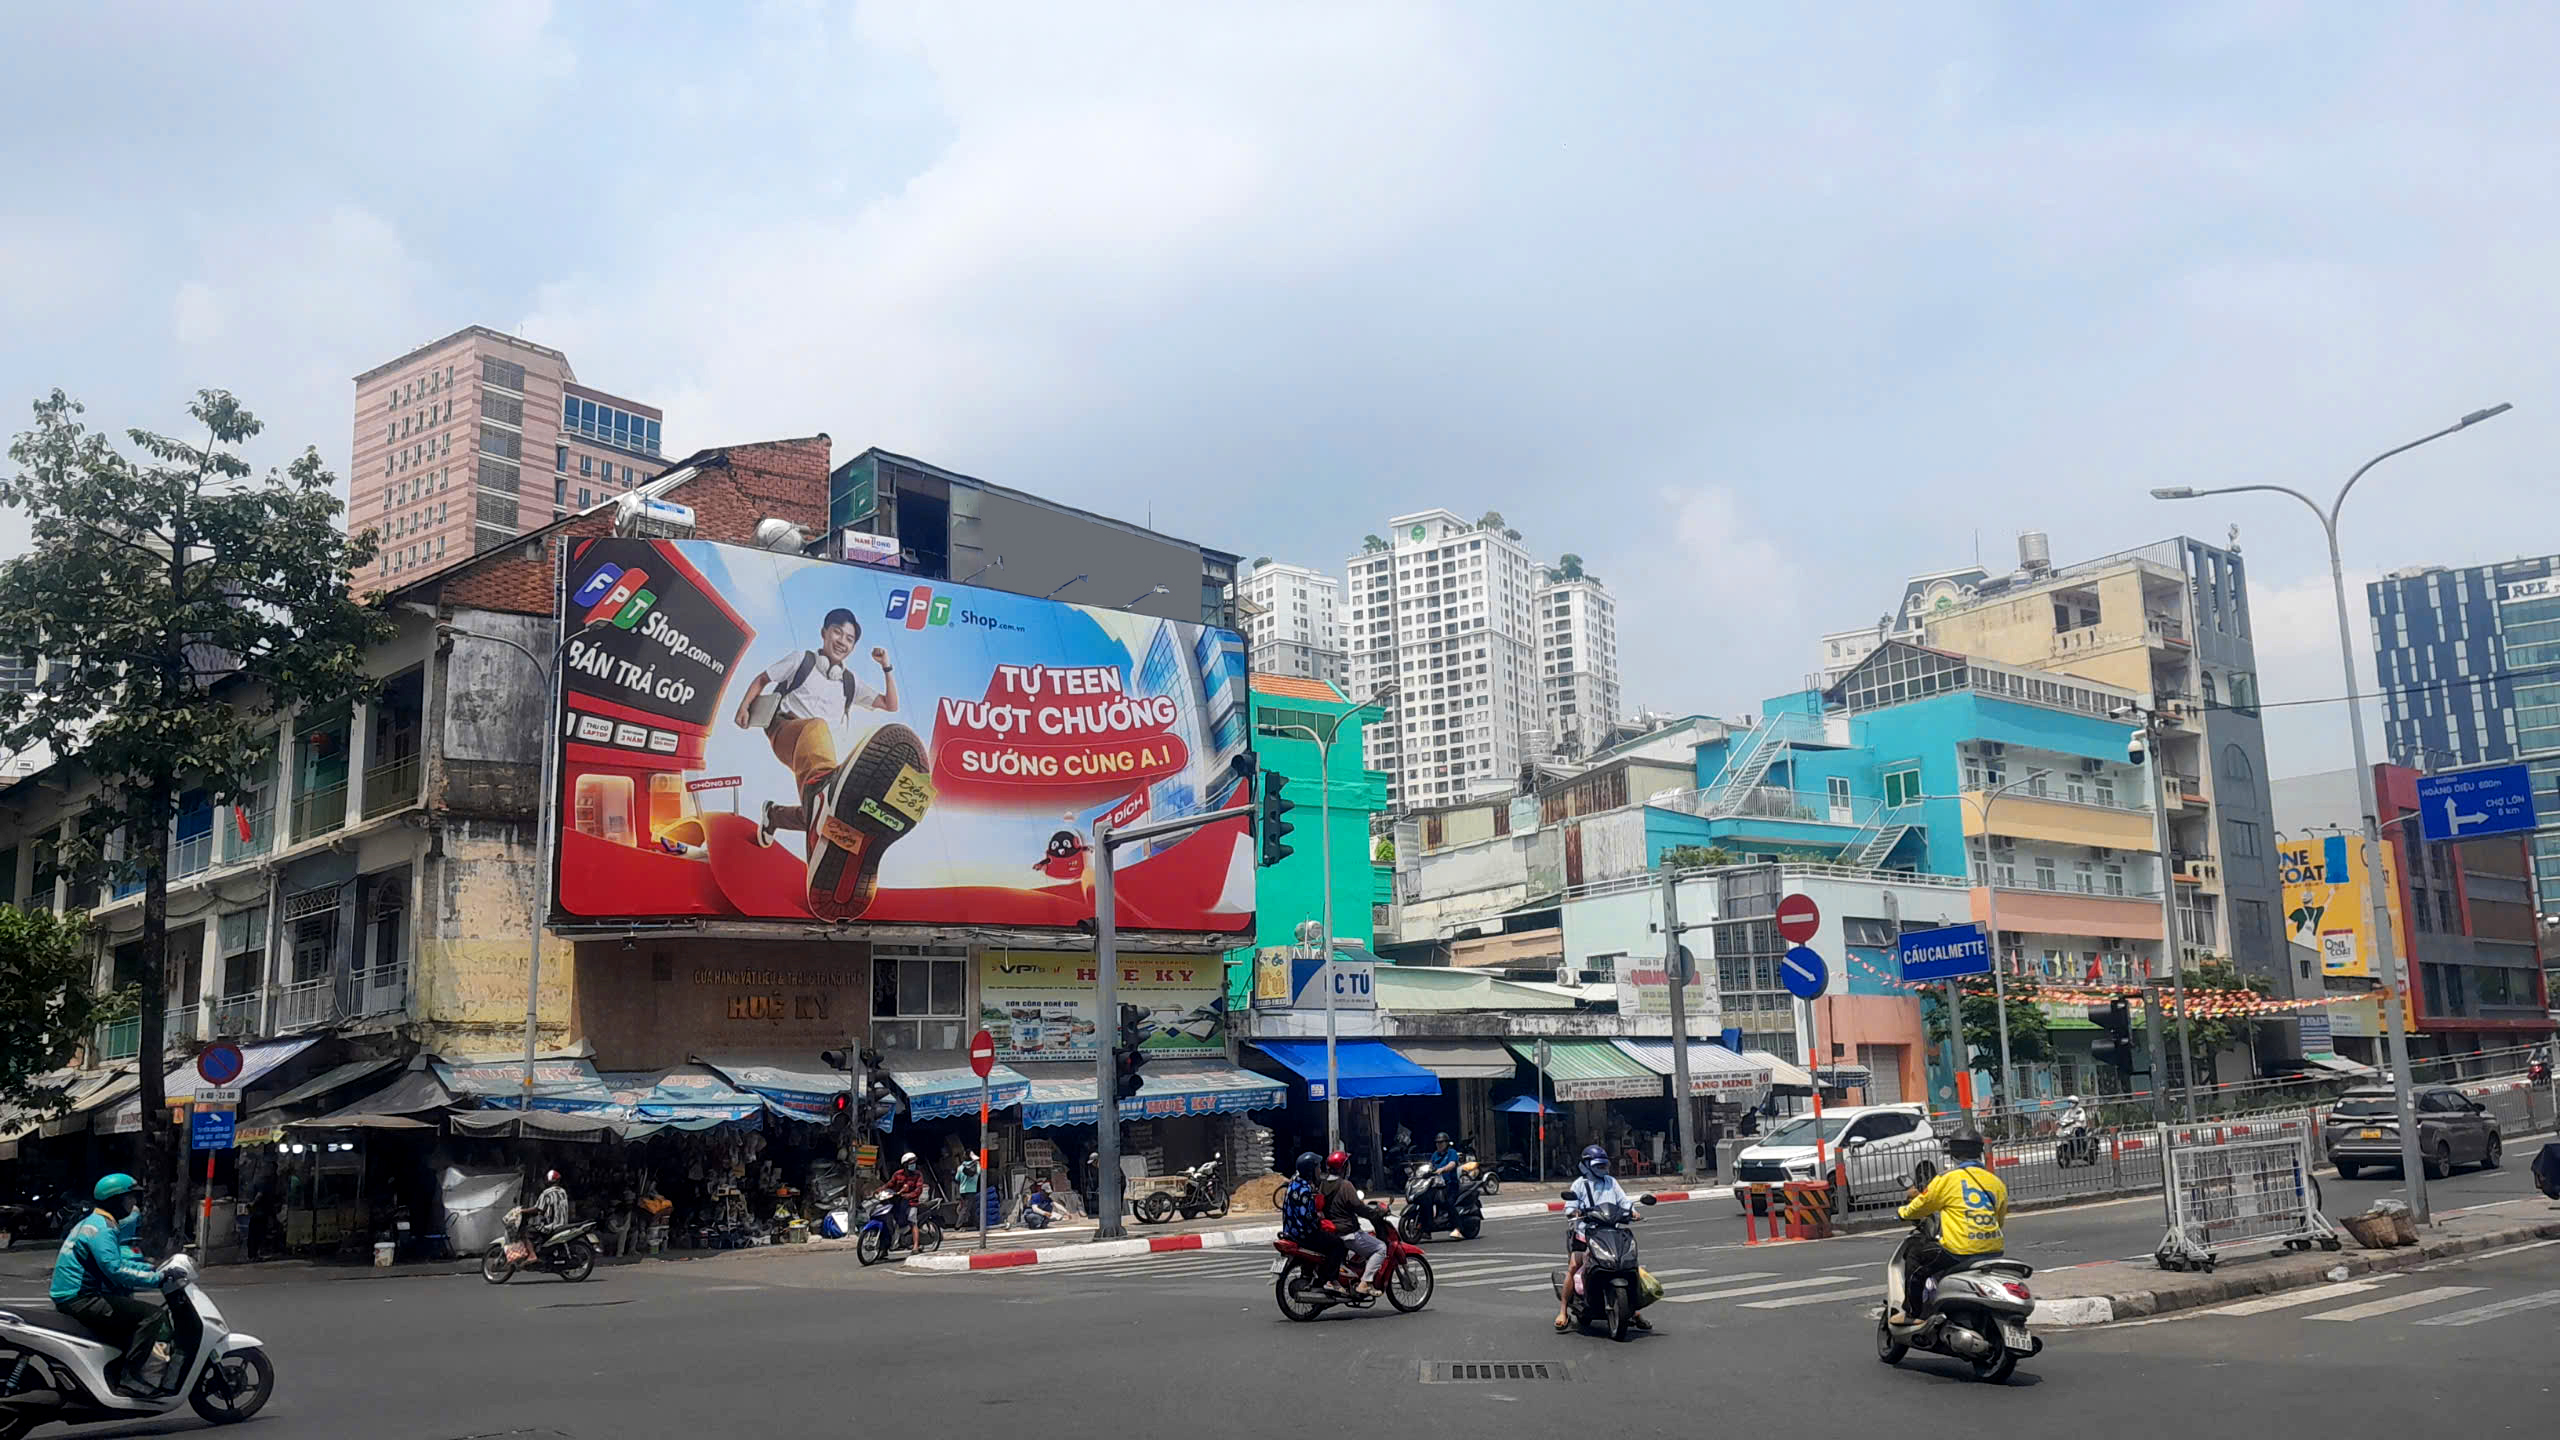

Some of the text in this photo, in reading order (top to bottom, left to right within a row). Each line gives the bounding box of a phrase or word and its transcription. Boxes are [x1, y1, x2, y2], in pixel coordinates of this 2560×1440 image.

[580, 568, 652, 624] FPT
[886, 591, 951, 625] FPT
[568, 640, 695, 705] BÁN TRẢ GÓP
[999, 665, 1122, 703] TỰ TEEN
[941, 695, 1177, 740] VƯỢT CHƯỚNG
[961, 745, 1171, 777] SƯỚNG CÙNG A.I
[2281, 850, 2310, 866] NE
[1903, 940, 1985, 965] CẦU CALMETTE
[1349, 969, 1370, 994] TÚ
